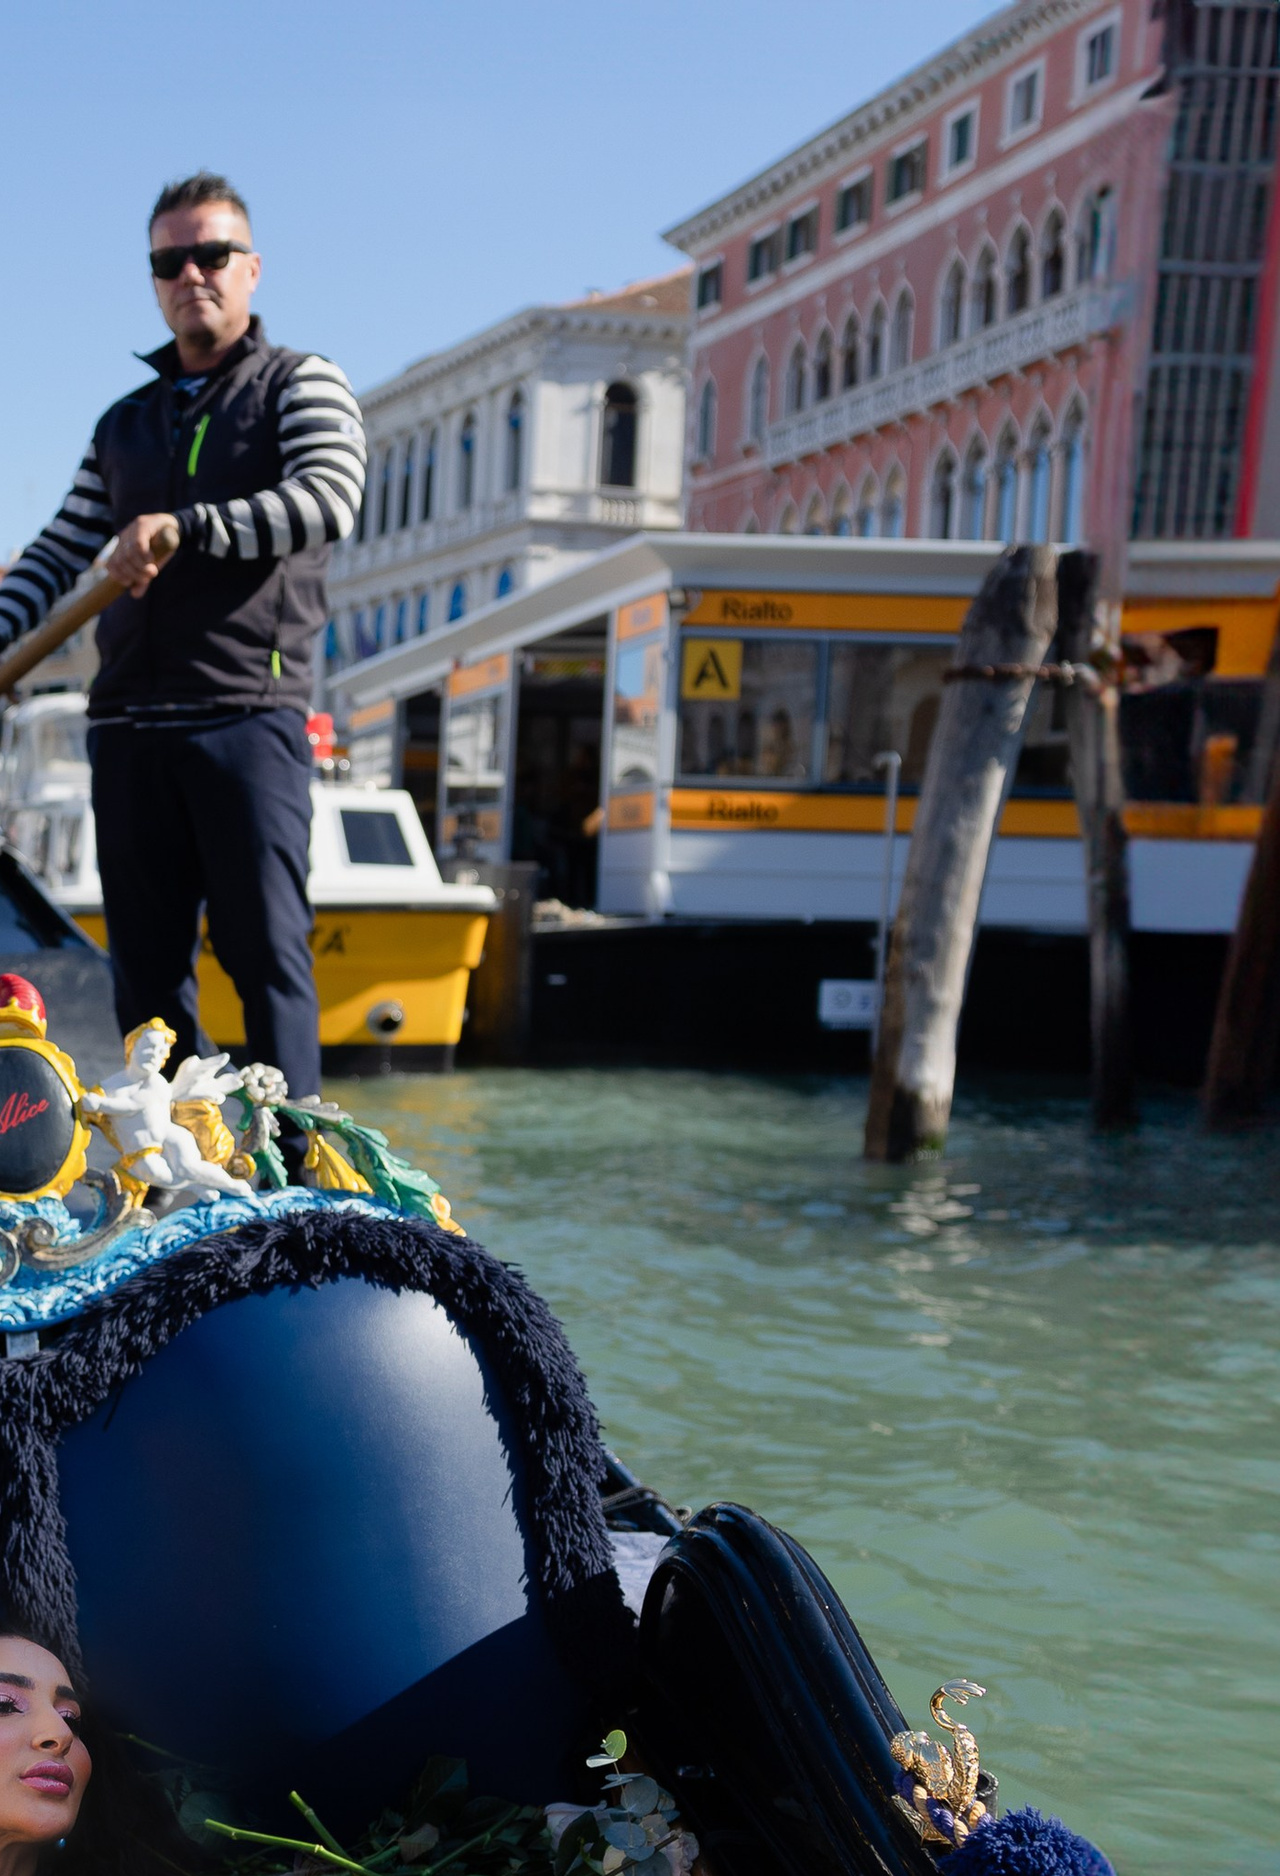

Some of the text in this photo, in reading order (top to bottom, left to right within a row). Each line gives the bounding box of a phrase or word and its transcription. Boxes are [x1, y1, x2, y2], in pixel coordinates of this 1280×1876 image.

[722, 597, 793, 620] Rialto
[694, 646, 730, 690] A
[706, 795, 780, 822] Rialto
